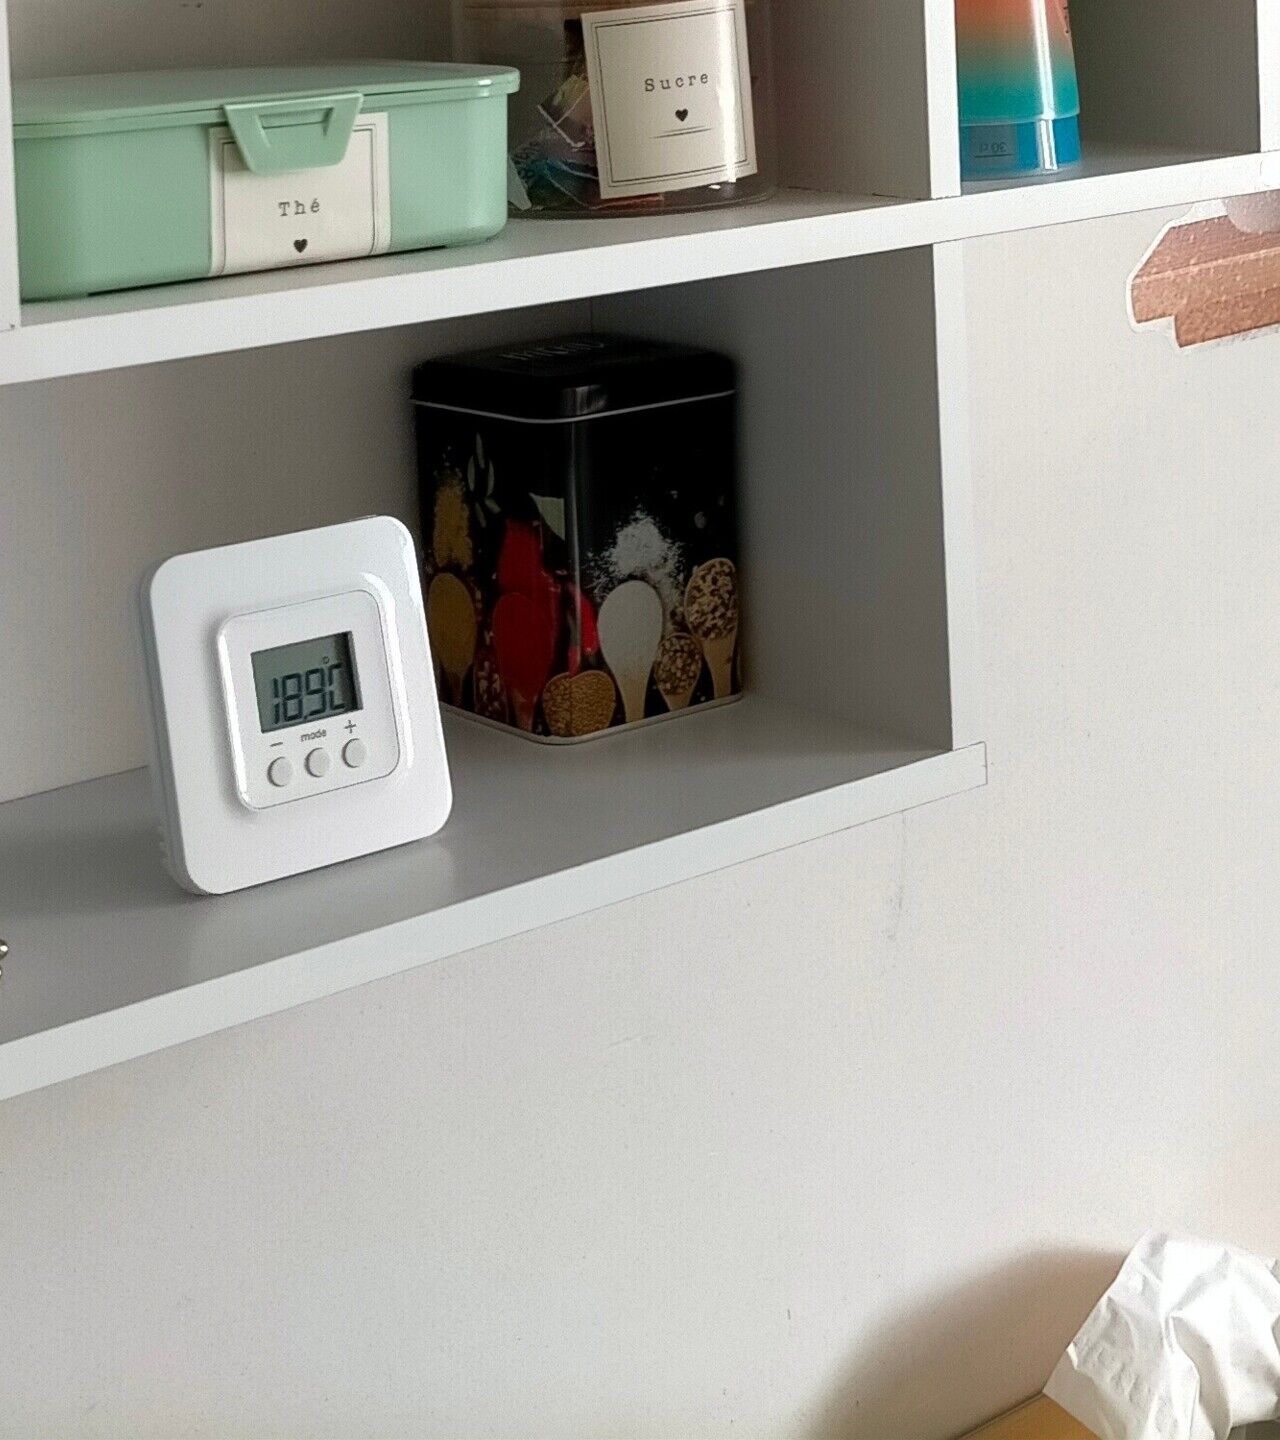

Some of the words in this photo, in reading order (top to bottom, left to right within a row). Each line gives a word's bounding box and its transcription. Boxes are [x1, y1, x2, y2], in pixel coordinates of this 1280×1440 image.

[644, 73, 709, 92] Sucre
[278, 198, 320, 216] Thé
[300, 729, 327, 742] mode
